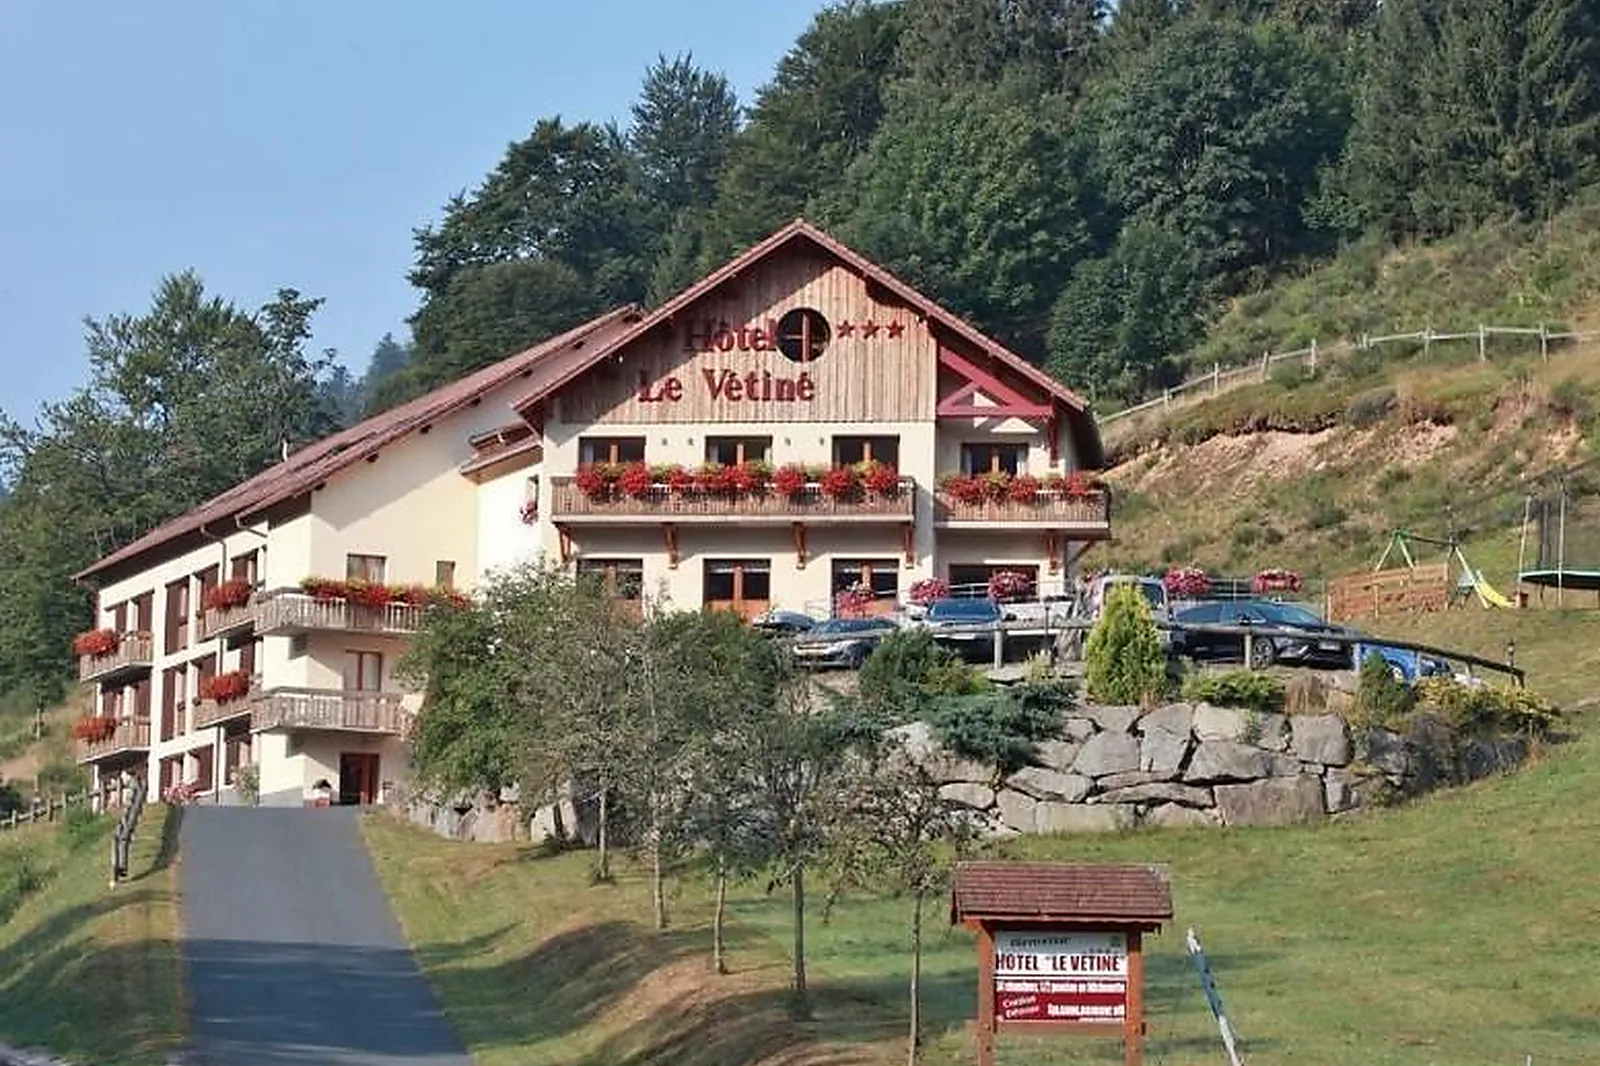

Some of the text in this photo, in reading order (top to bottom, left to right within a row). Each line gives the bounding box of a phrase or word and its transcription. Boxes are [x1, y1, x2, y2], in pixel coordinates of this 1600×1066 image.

[683, 319, 777, 352] Hôtel
[638, 367, 815, 402] Le Vétiné
[995, 953, 1039, 971] HOTEL
